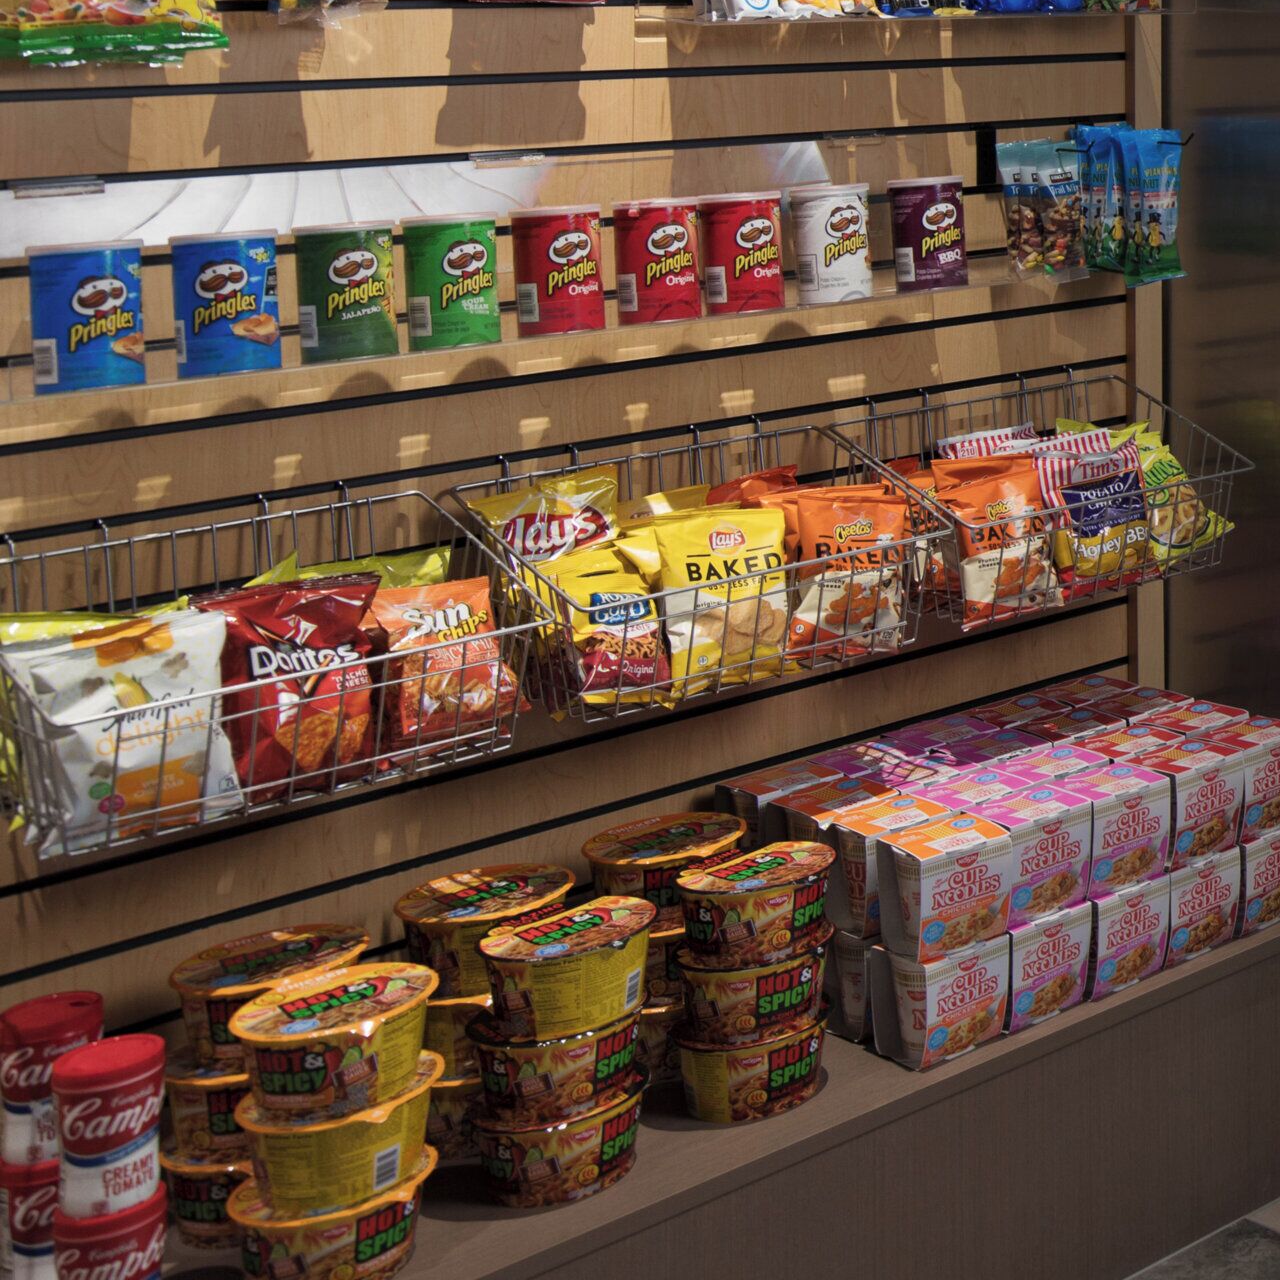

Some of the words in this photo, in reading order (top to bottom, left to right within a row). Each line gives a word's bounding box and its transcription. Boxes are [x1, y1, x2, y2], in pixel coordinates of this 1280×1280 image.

[824, 231, 867, 268] Pringles
[921, 223, 962, 259] Pringles
[936, 248, 963, 264] BBQ
[547, 257, 597, 296] Pringles
[645, 249, 694, 287] Pringles
[734, 242, 779, 279] Pringles
[441, 269, 494, 310] Pringles
[568, 281, 599, 296] Original
[665, 272, 695, 287] Original
[193, 291, 257, 336] Pringles
[327, 277, 386, 321] Pringles
[69, 308, 135, 353] Pringles
[960, 448, 975, 457] 210
[1079, 458, 1121, 480] Tim's
[1080, 481, 1124, 501] POTATO
[986, 500, 1014, 522] Cheetos
[834, 521, 873, 543] Cheetos
[1075, 535, 1121, 559] Honey
[685, 551, 783, 583] BAKED
[401, 601, 471, 638] Sun
[249, 644, 360, 676] Doritos
[95, 708, 209, 757] delight
[1184, 788, 1236, 822] NOODLES
[1196, 778, 1226, 803] CUP
[1102, 815, 1161, 850] NOODLES
[1116, 806, 1150, 831] CUP
[1020, 839, 1081, 877] NOODLES
[1035, 831, 1070, 856] CUP
[710, 857, 759, 878] HOT
[726, 856, 787, 881] SPICY
[947, 864, 989, 889] CUP
[931, 874, 1002, 910] NOODLES
[1177, 883, 1232, 919] NOODLES
[1190, 874, 1222, 899] CUP
[793, 898, 826, 929] SPIC
[942, 901, 977, 917] CHICKEN
[1119, 903, 1151, 930] CUP
[517, 916, 577, 941] HOT
[531, 915, 604, 945] SPICY
[1106, 912, 1160, 951] NOODLES
[1022, 941, 1081, 982] NOODLES
[1036, 933, 1071, 960] CUP
[280, 985, 350, 1012] HOT
[347, 979, 370, 993] &
[759, 968, 802, 998] HOT
[800, 966, 812, 982] &
[936, 974, 999, 1017] NOODLES
[950, 966, 988, 994] CUP
[290, 986, 378, 1020] SPICY
[757, 981, 811, 1016] SPICY
[597, 1028, 634, 1061] HOT
[769, 1040, 811, 1069] HOT
[304, 1052, 326, 1070] &
[603, 1106, 636, 1144] HOT
[358, 1201, 405, 1241] HOT
